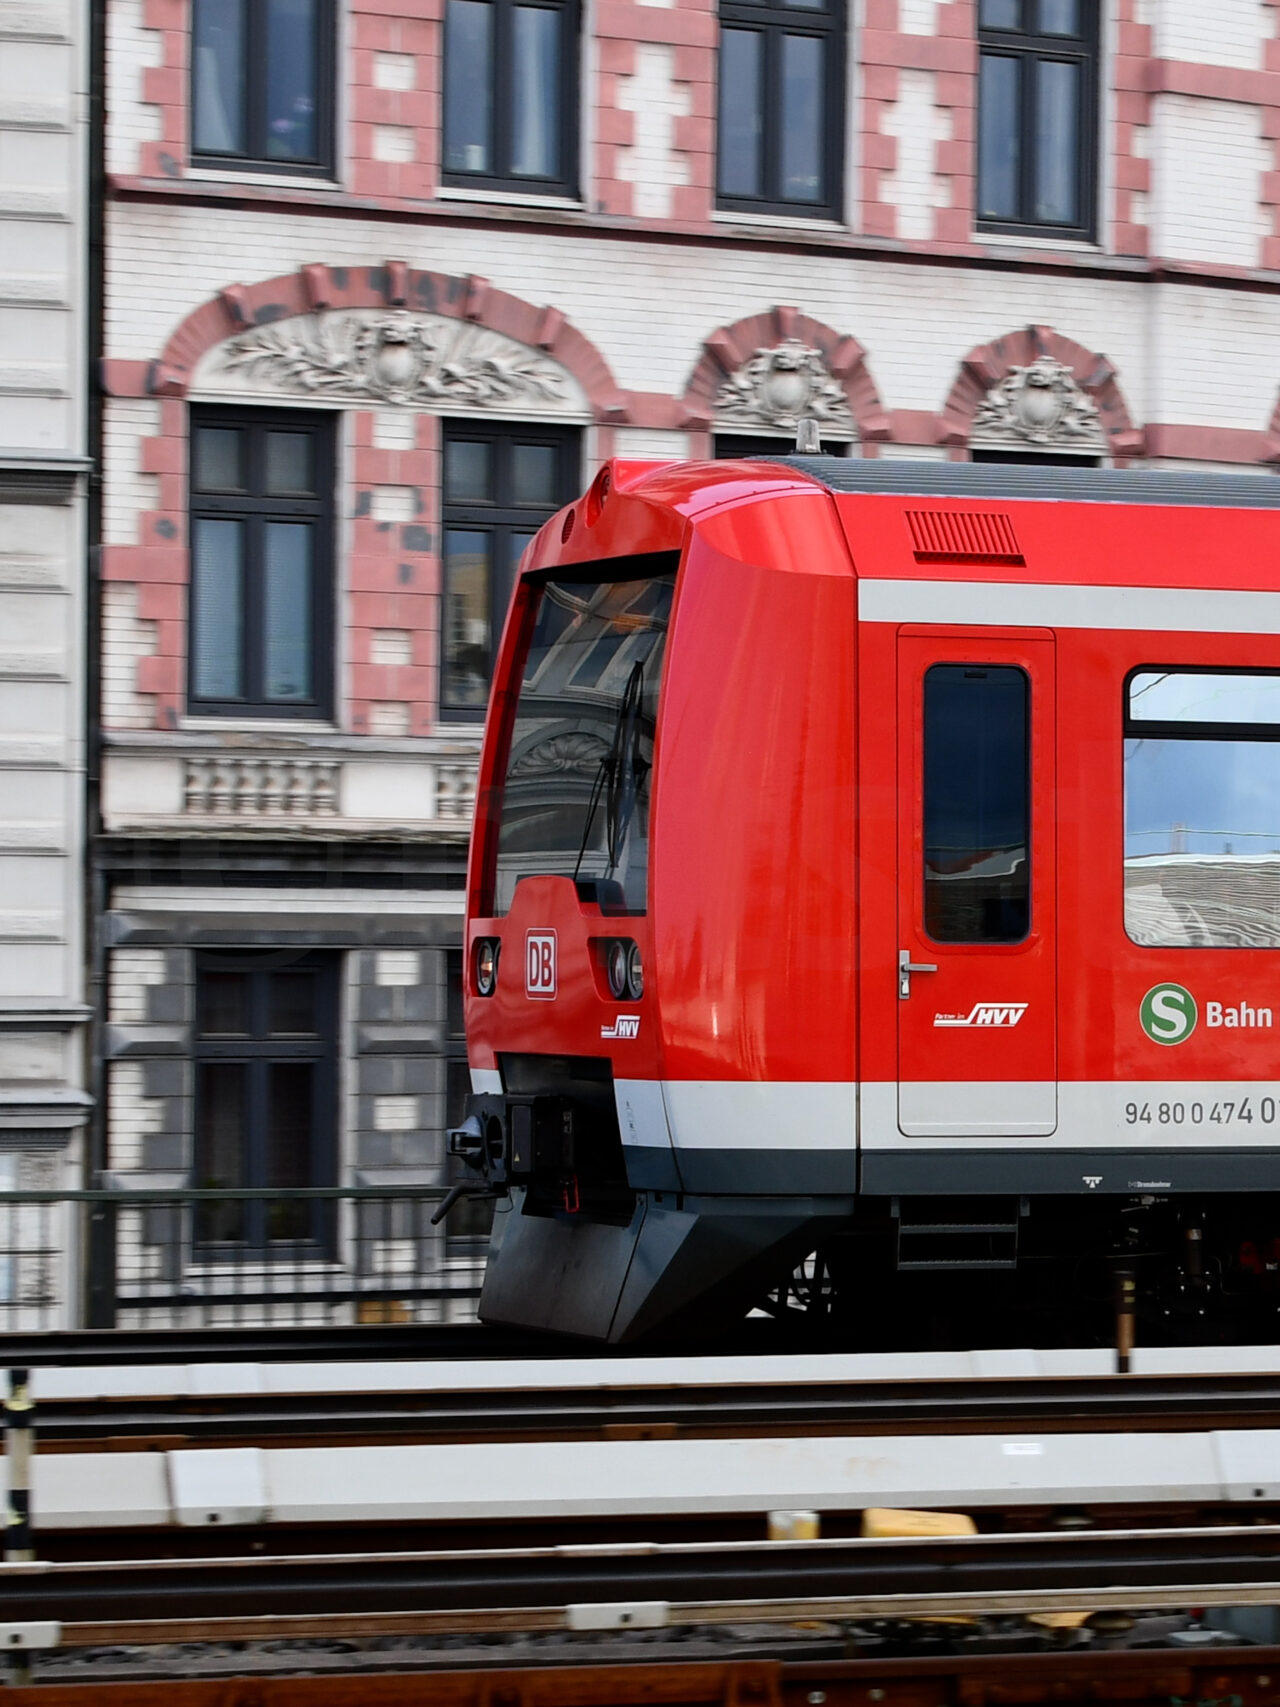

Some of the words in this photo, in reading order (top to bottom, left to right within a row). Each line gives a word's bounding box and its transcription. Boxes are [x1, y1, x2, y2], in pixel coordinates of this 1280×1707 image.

[529, 941, 552, 987] DB
[976, 1008, 1026, 1025] HVV
[1151, 988, 1188, 1039] S
[1206, 1001, 1272, 1028] Bahn
[618, 1020, 640, 1036] HVV
[1125, 1102, 1152, 1124] 94
[1158, 1102, 1185, 1124] 80
[1191, 1102, 1203, 1124] 0
[1209, 1097, 1253, 1124] 474
